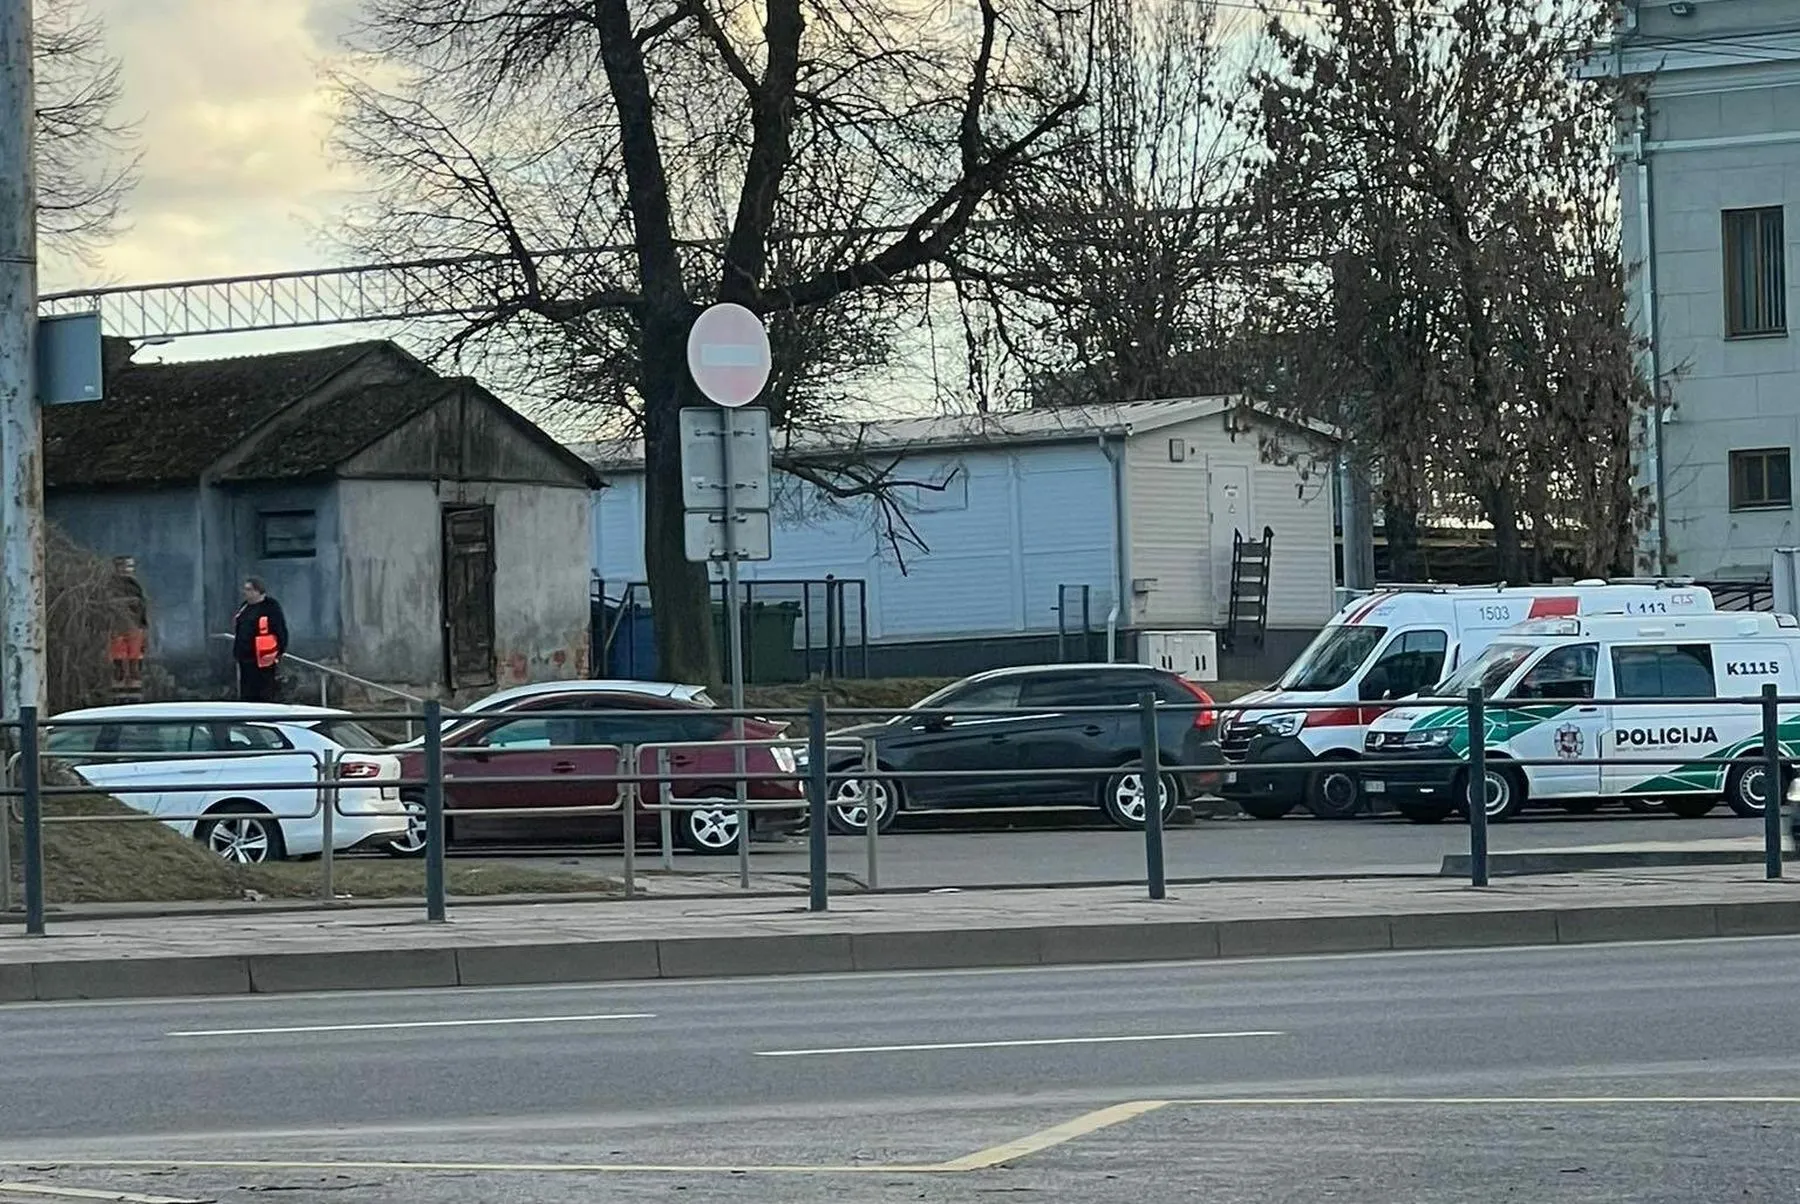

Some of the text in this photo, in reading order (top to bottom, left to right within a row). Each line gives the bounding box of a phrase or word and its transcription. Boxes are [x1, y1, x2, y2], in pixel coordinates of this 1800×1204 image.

[1479, 606, 1510, 620] 1503
[1727, 662, 1779, 675] K1115
[1616, 727, 1718, 745] POLICIJA
